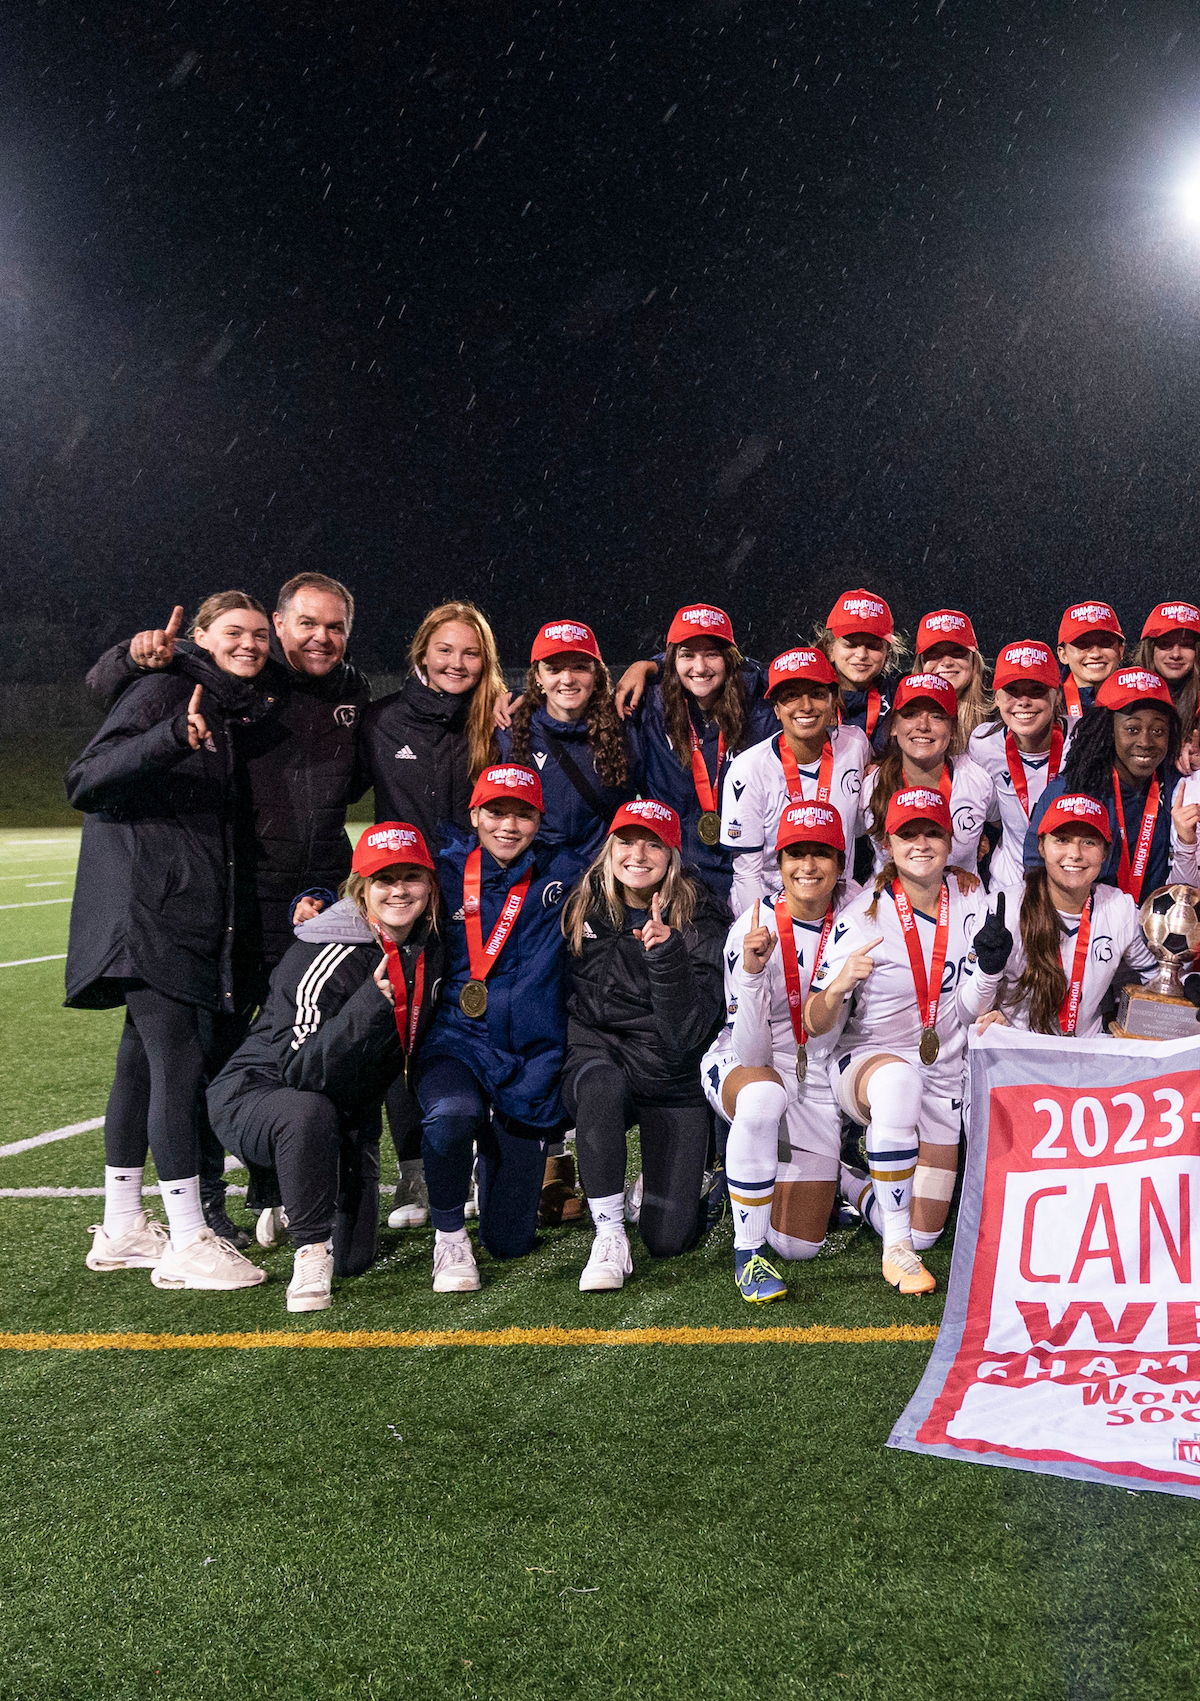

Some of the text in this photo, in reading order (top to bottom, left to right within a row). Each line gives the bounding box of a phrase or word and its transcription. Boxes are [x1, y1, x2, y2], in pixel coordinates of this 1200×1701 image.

[844, 600, 883, 614] CHAMPIONS
[1071, 605, 1111, 619] CHAMPIONS
[682, 609, 725, 624] CHAMPIONS
[926, 615, 965, 629] CHAMPIONS
[545, 624, 588, 639] CHAMPIONS
[774, 652, 816, 670] CHAMPIONS
[1005, 647, 1047, 663] CHAMPIONS
[906, 674, 948, 690] CHAMPIONS
[1118, 672, 1161, 686] CHAMPIONS
[487, 768, 534, 785] CHAMPIONS
[897, 790, 943, 805] CHAMPIONS
[1056, 797, 1101, 814] CHAMPIONS
[626, 801, 672, 821] CHAMPIONS
[787, 807, 833, 822] CHAMPIONS
[368, 829, 416, 846] CHAMPIONS
[1133, 814, 1154, 876] WOMEN'S SOCCER
[895, 893, 914, 932] 2023-2024
[485, 894, 522, 956] WOMEN'S SOCCER
[1069, 981, 1080, 1018] WOMEN'S
